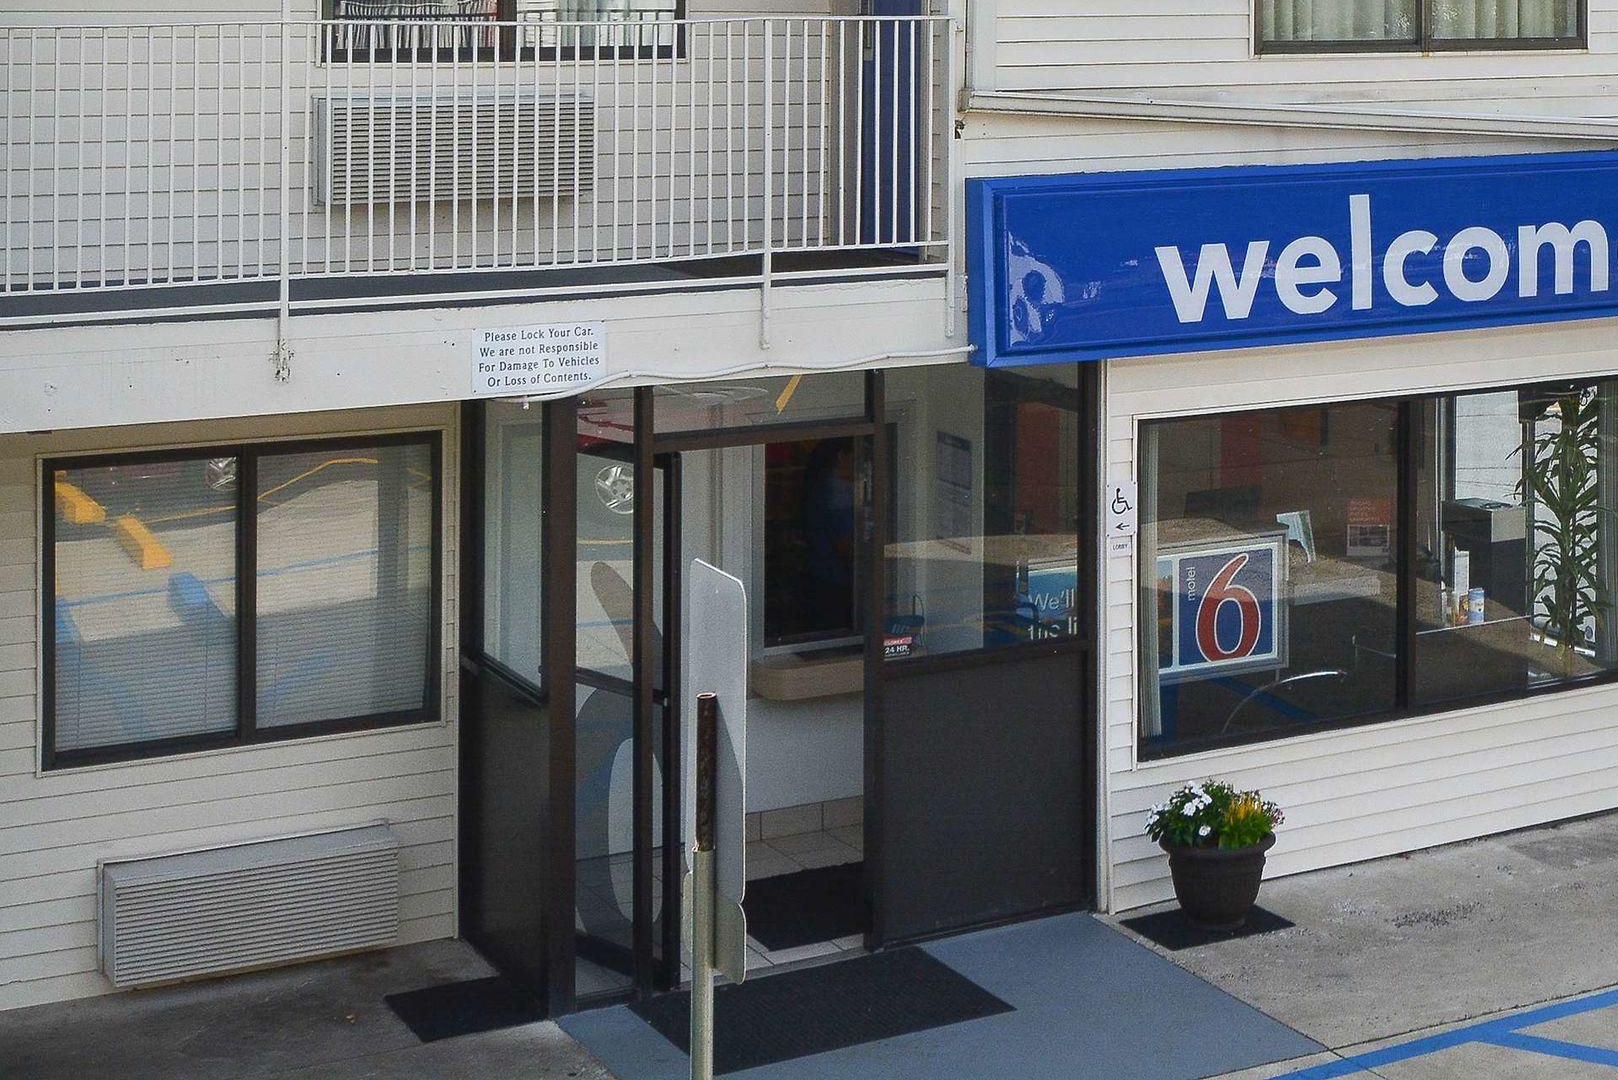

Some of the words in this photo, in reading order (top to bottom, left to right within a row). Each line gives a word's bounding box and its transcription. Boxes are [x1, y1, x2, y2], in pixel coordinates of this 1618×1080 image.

[484, 332, 517, 342] Please
[521, 329, 545, 340] Lock
[548, 328, 571, 338] Your
[574, 326, 594, 337] Car.
[479, 347, 495, 358] We
[499, 348, 515, 356] are
[518, 346, 535, 355] not
[539, 341, 599, 354] Responsible
[478, 362, 496, 373] For
[500, 360, 539, 371] Damage
[543, 358, 555, 369] To
[558, 356, 600, 367] Vehicles
[487, 377, 501, 387] Or
[505, 375, 527, 386] Loss
[530, 373, 540, 384] of
[543, 371, 592, 383] Contents.
[1187, 566, 1196, 601] motel
[1028, 589, 1075, 611] We'll
[1195, 552, 1261, 663] 6
